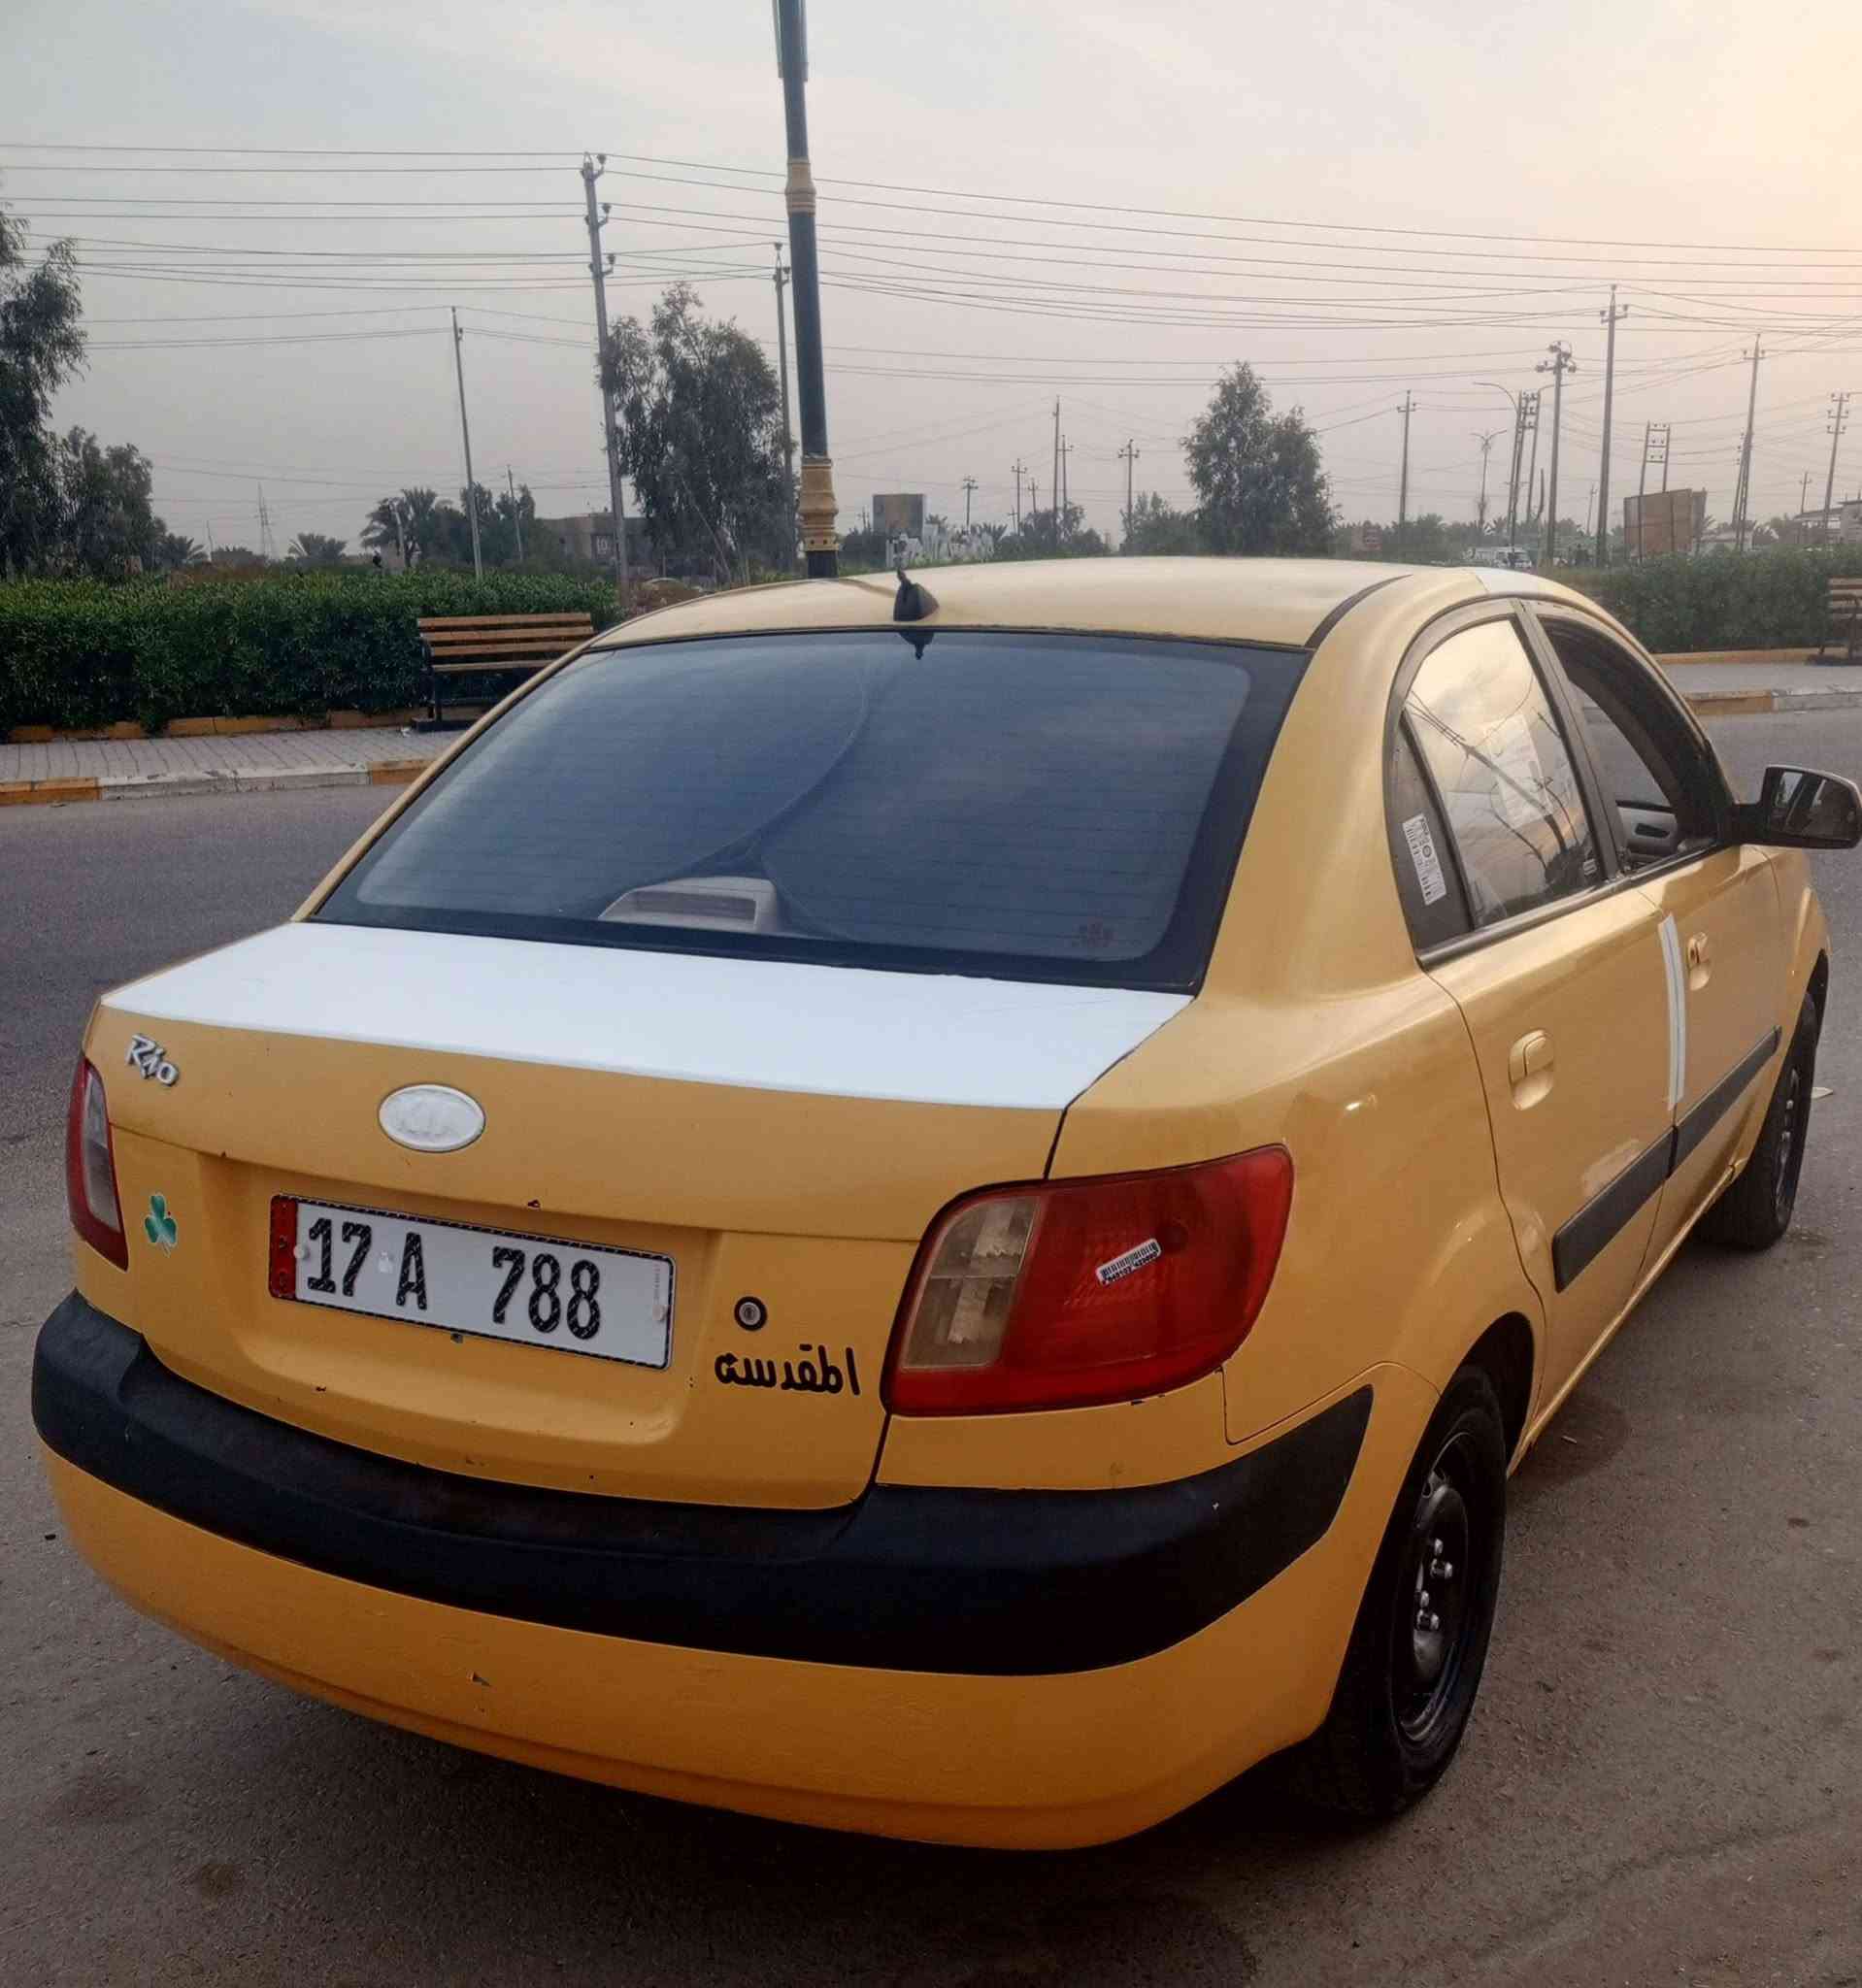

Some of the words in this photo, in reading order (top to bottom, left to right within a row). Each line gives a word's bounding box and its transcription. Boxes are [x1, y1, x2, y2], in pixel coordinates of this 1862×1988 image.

[126, 1034, 179, 1086] Rio
[308, 1217, 372, 1297] 17
[396, 1232, 427, 1309] A
[492, 1246, 600, 1340] 788
